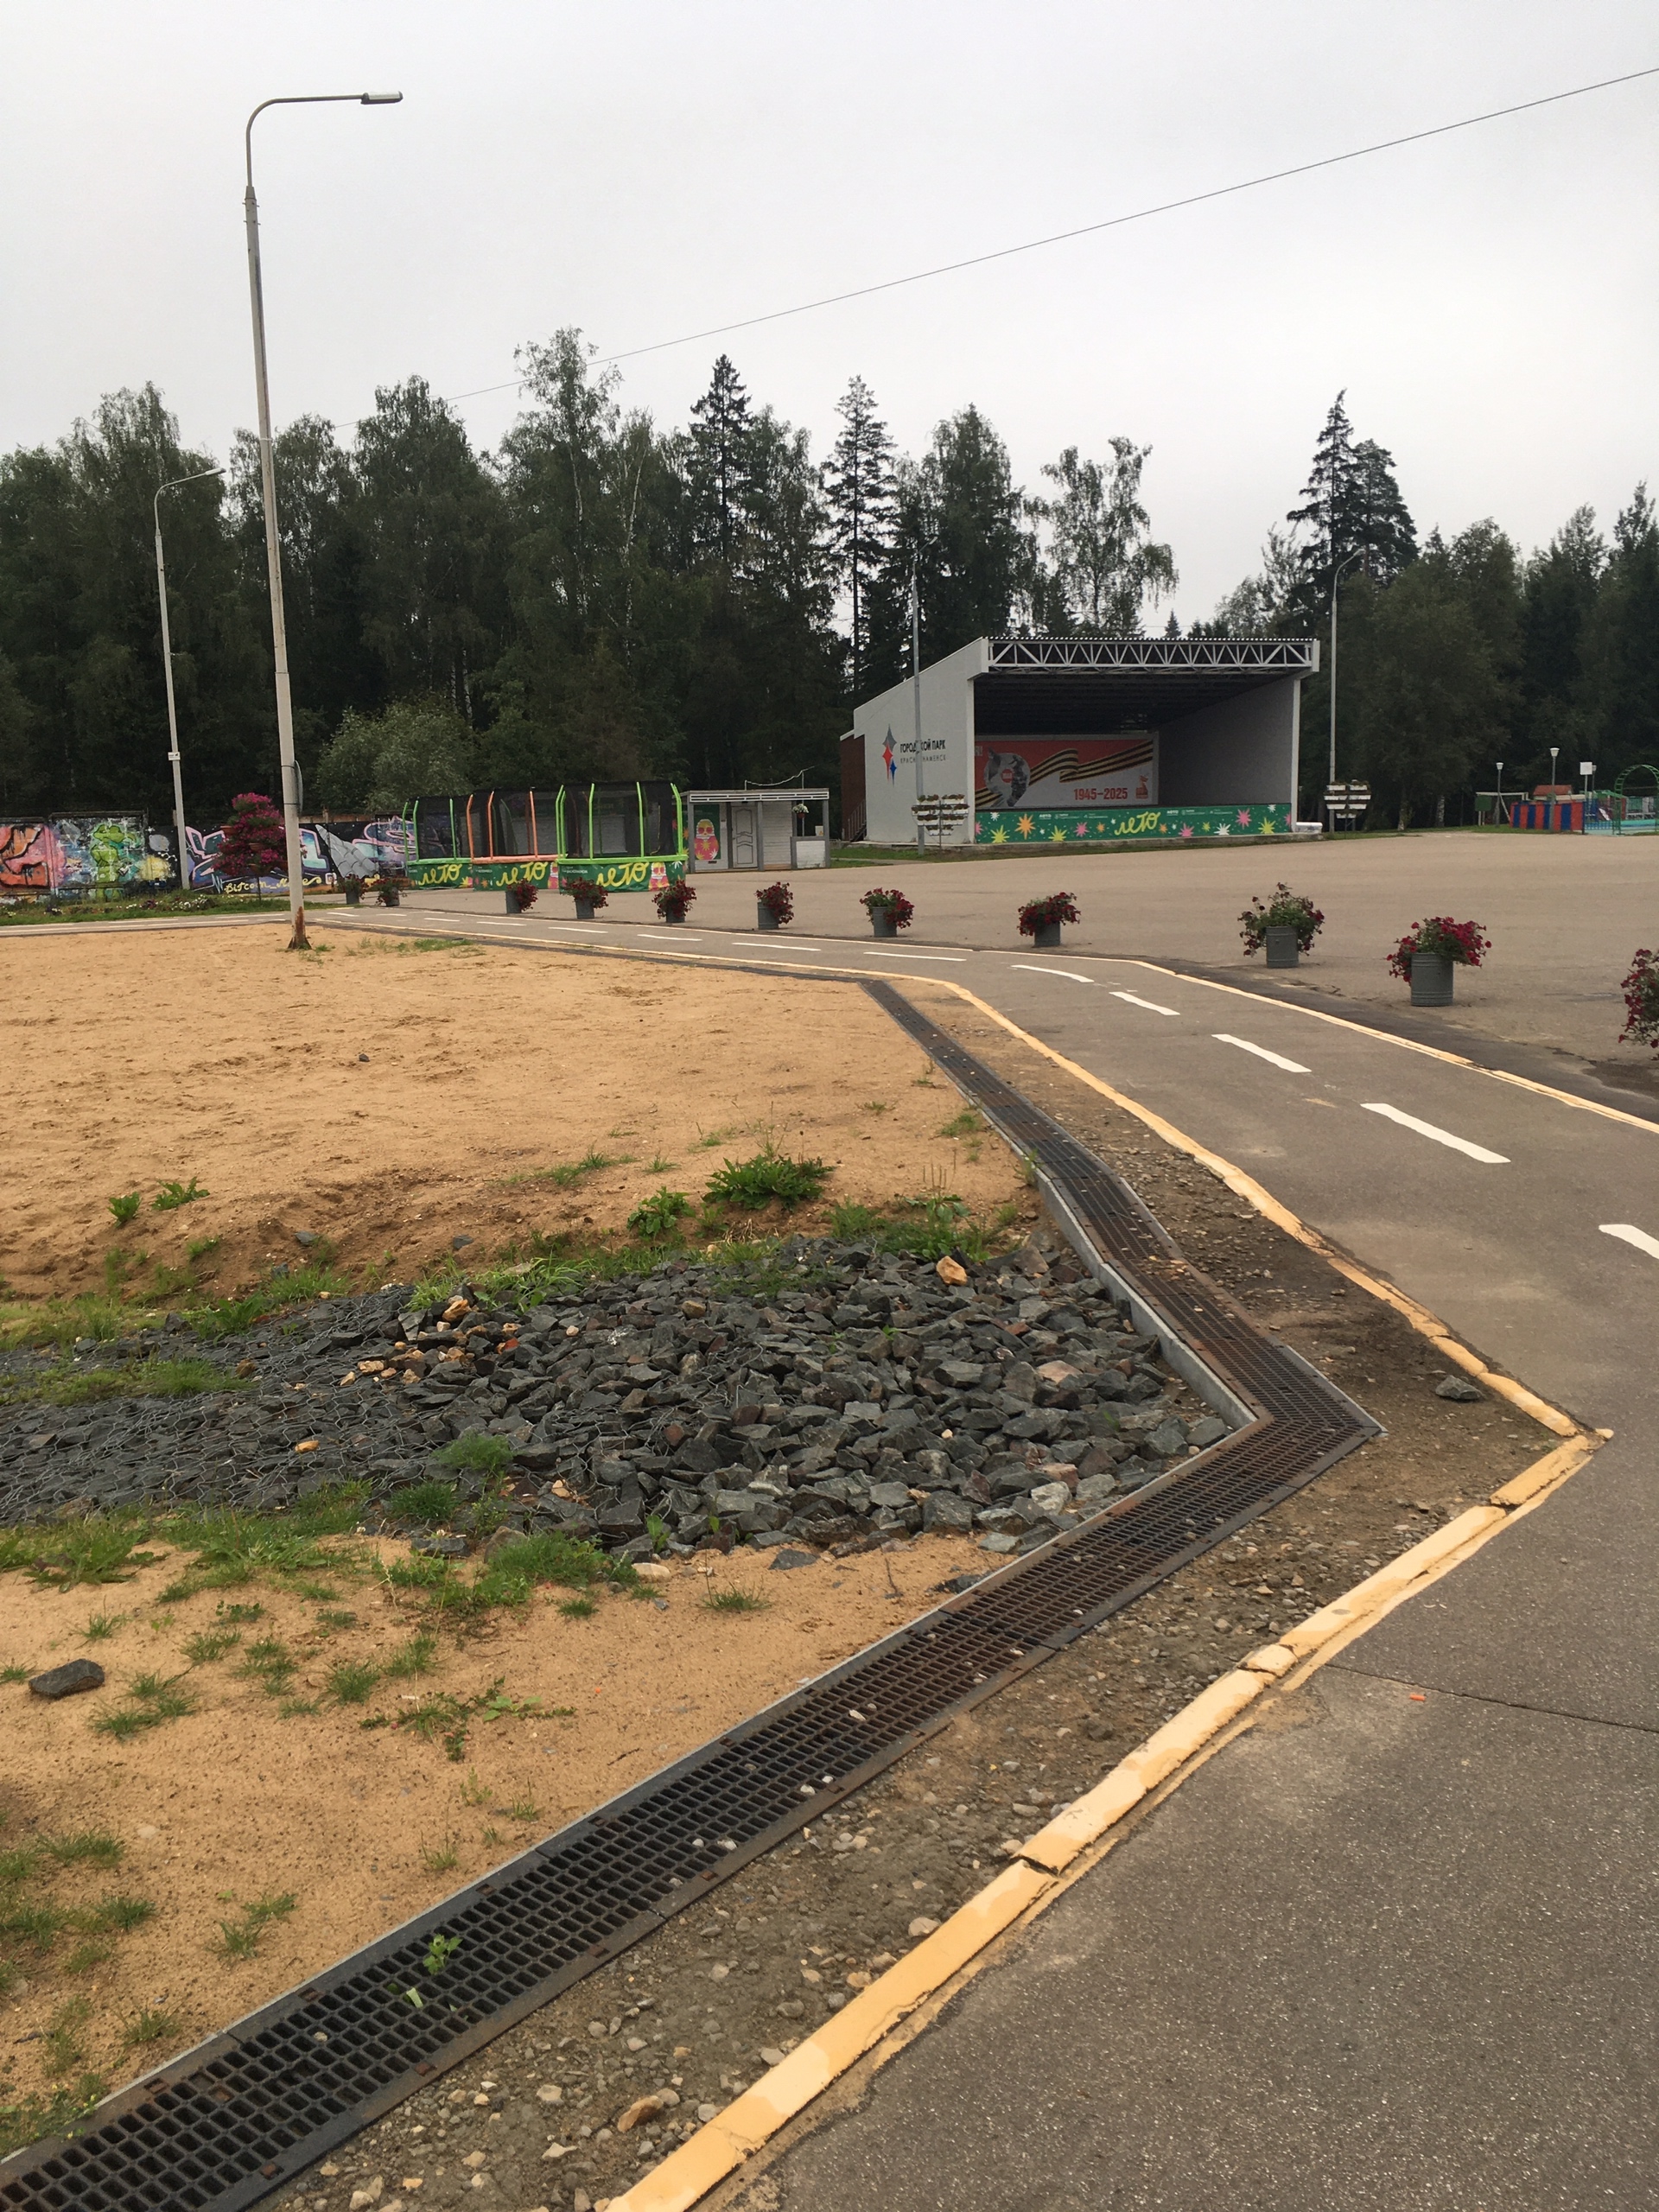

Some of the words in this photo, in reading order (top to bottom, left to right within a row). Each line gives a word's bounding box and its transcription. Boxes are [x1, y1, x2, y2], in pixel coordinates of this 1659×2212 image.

[900, 739, 931, 753] ГОРОДКОЙ
[932, 740, 946, 750] ПАРК
[900, 754, 946, 764] КРАСННАМЕНСК
